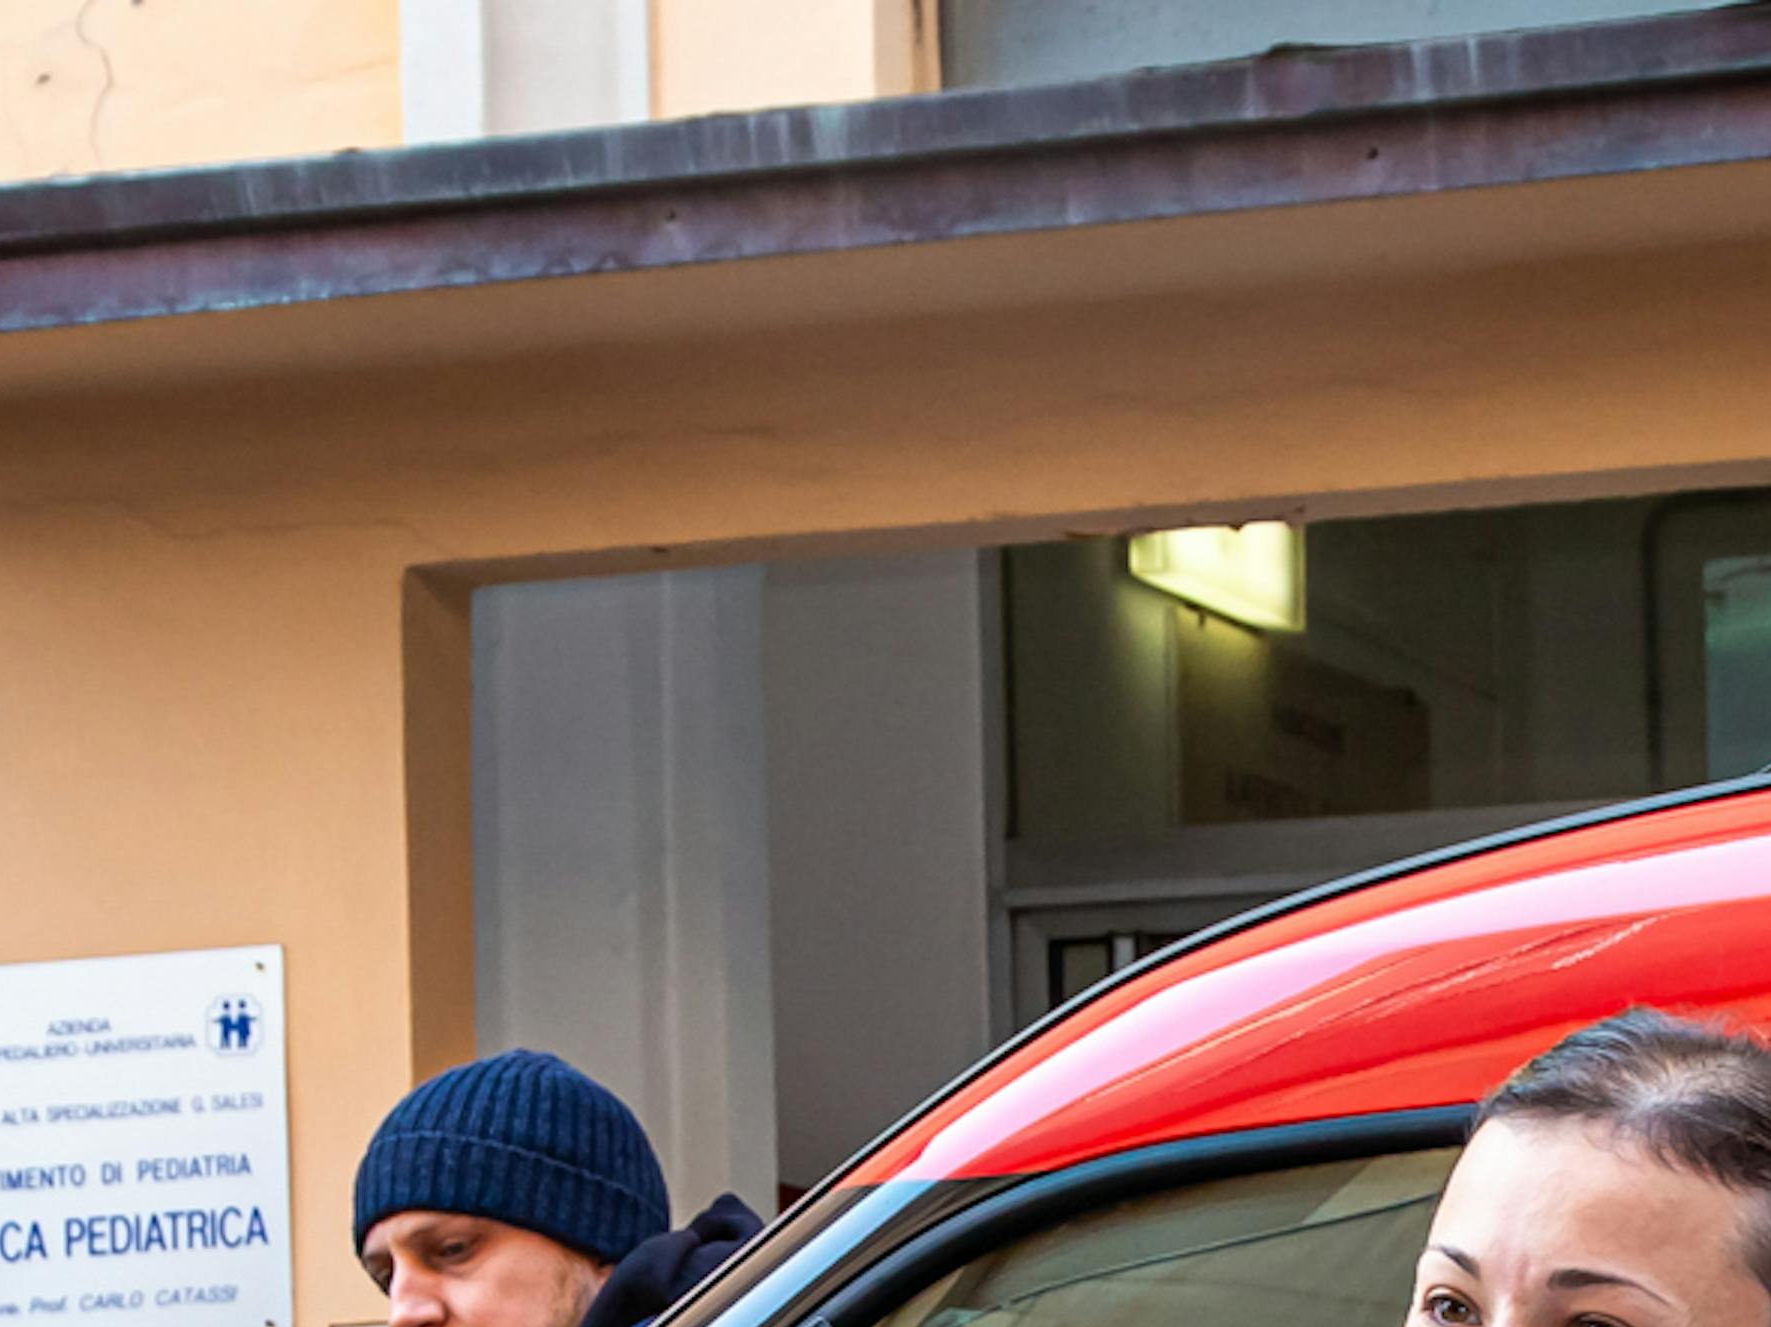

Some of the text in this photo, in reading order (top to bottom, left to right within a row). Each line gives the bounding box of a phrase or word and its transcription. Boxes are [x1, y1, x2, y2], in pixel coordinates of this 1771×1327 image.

[47, 1017, 111, 1035] AZIENDA
[1, 1106, 41, 1126] ALTA
[47, 1097, 182, 1124] SPECIALIZZAZIONE
[211, 1092, 265, 1111] SALESI
[101, 1161, 123, 1185] DI
[137, 1153, 253, 1182] PEDIATRIA
[65, 1205, 269, 1258] PEDIATRICA
[79, 1290, 144, 1312] CARLO
[155, 1285, 239, 1307] CATASSI
